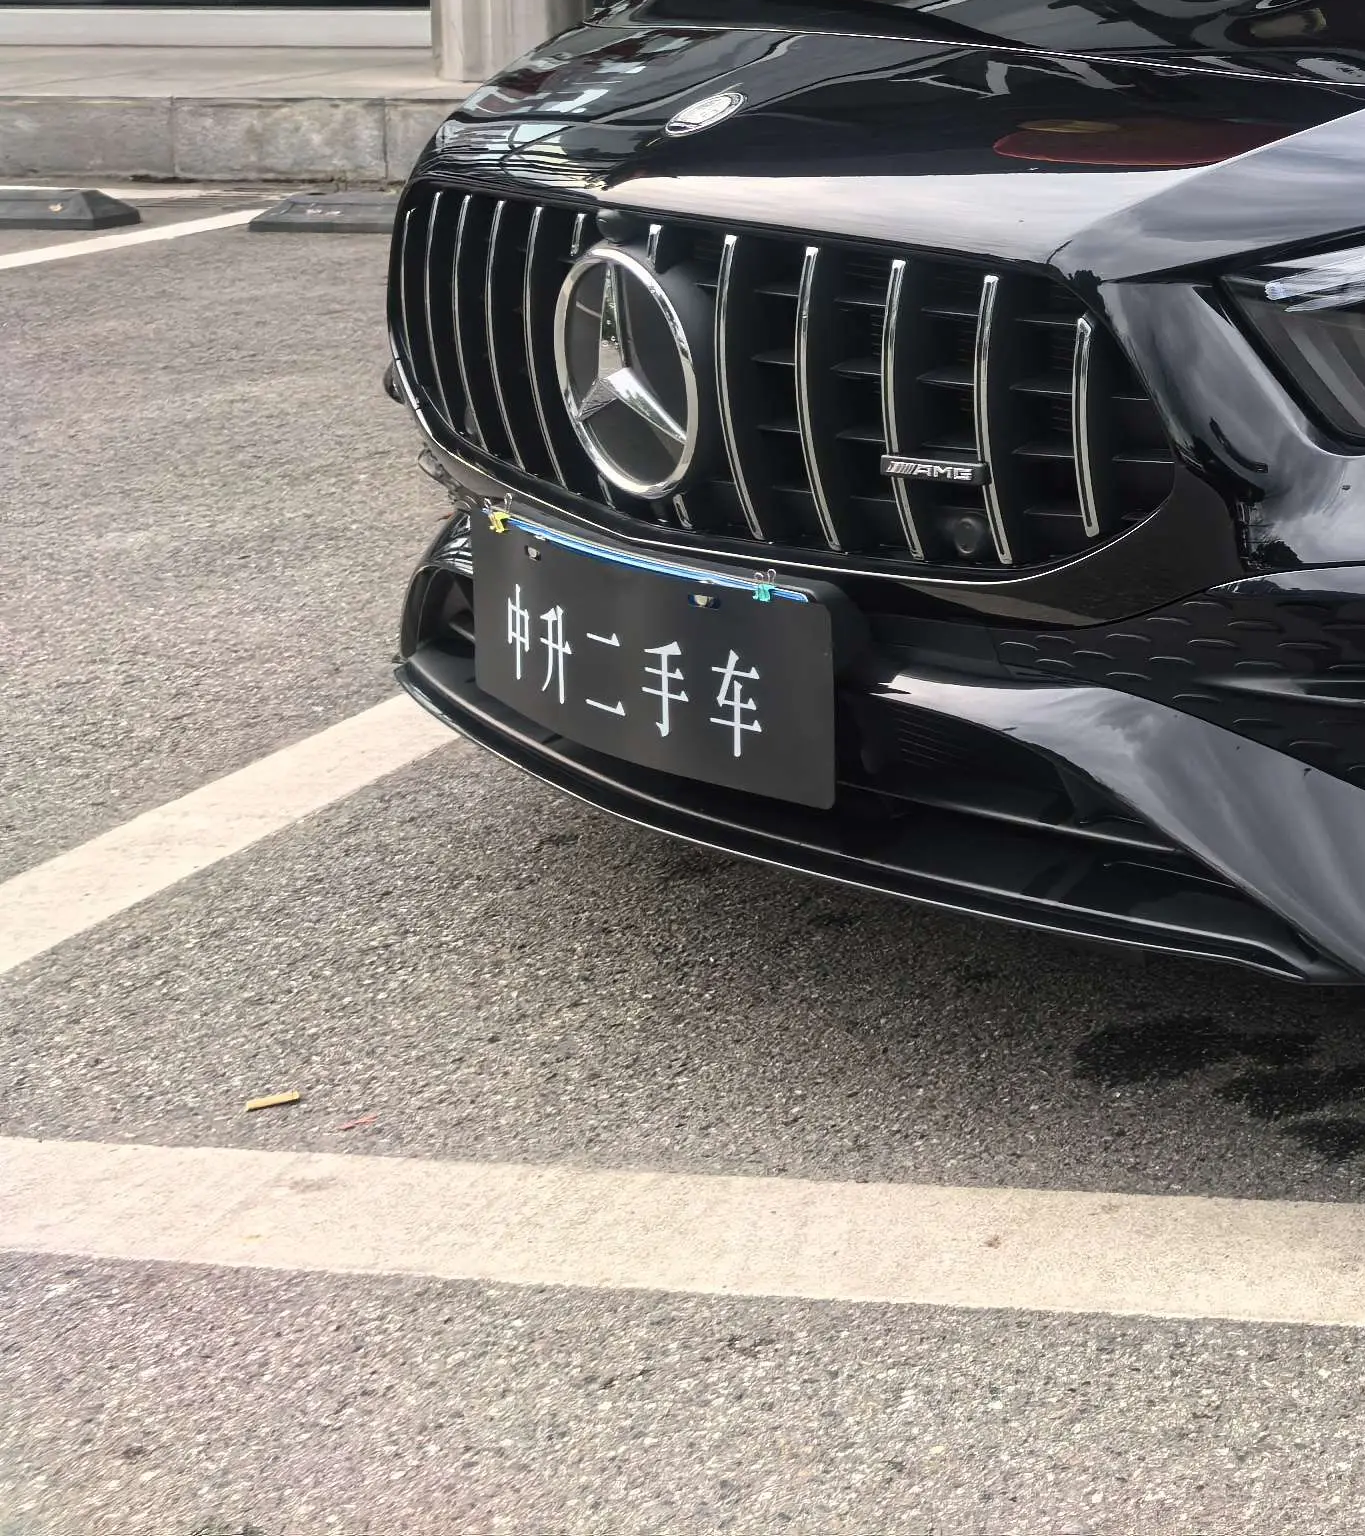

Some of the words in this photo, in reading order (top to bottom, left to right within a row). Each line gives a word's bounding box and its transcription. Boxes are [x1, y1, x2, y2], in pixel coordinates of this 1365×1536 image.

[507, 583, 762, 758] 中升二手车
